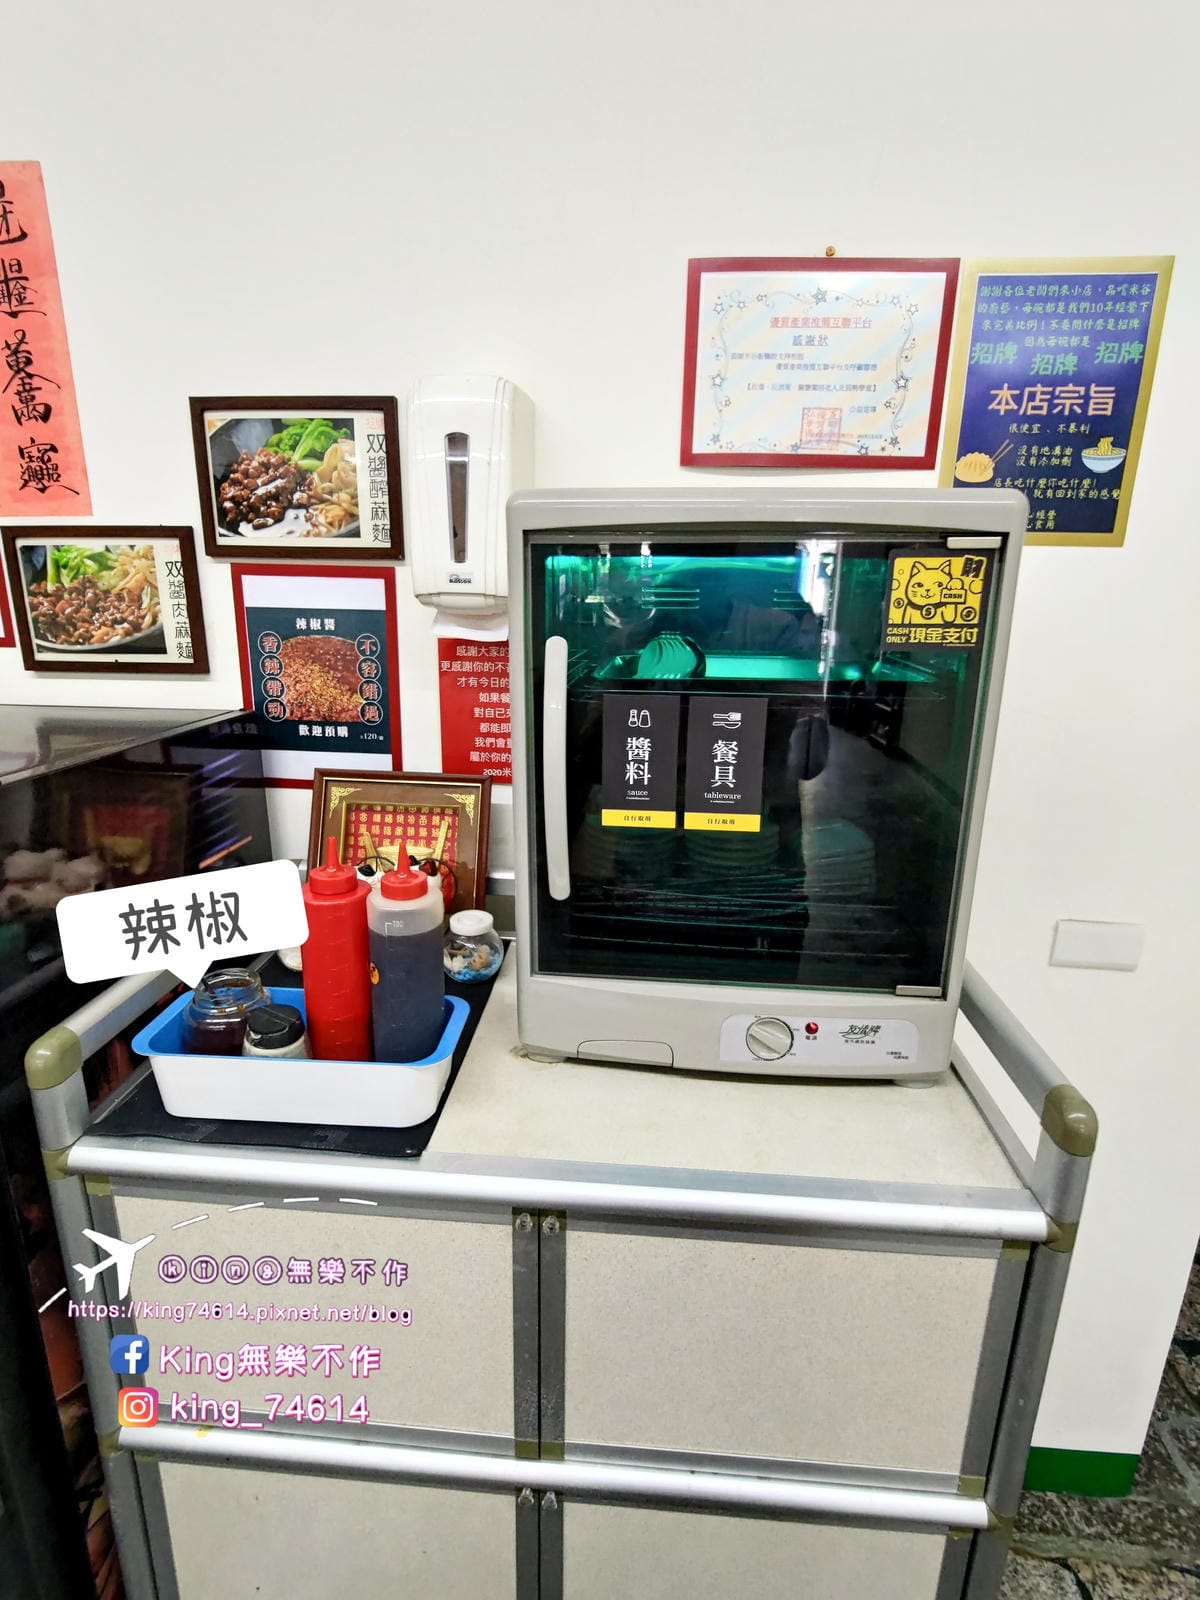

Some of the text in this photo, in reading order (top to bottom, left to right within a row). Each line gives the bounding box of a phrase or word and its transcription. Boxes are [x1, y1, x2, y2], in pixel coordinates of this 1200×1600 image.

[970, 342, 1018, 365] 招牌
[1030, 352, 1079, 376] 招牌
[1094, 341, 1144, 365] 招牌
[987, 383, 1116, 416] 本店宗旨
[295, 617, 336, 631] 辣椒醬
[886, 627, 909, 635] CASH
[909, 627, 979, 643] 現金支付
[440, 660, 510, 673] 更感謝你的不
[625, 736, 652, 785] 醬料
[710, 740, 739, 788] 餐具
[704, 791, 742, 800] tableware
